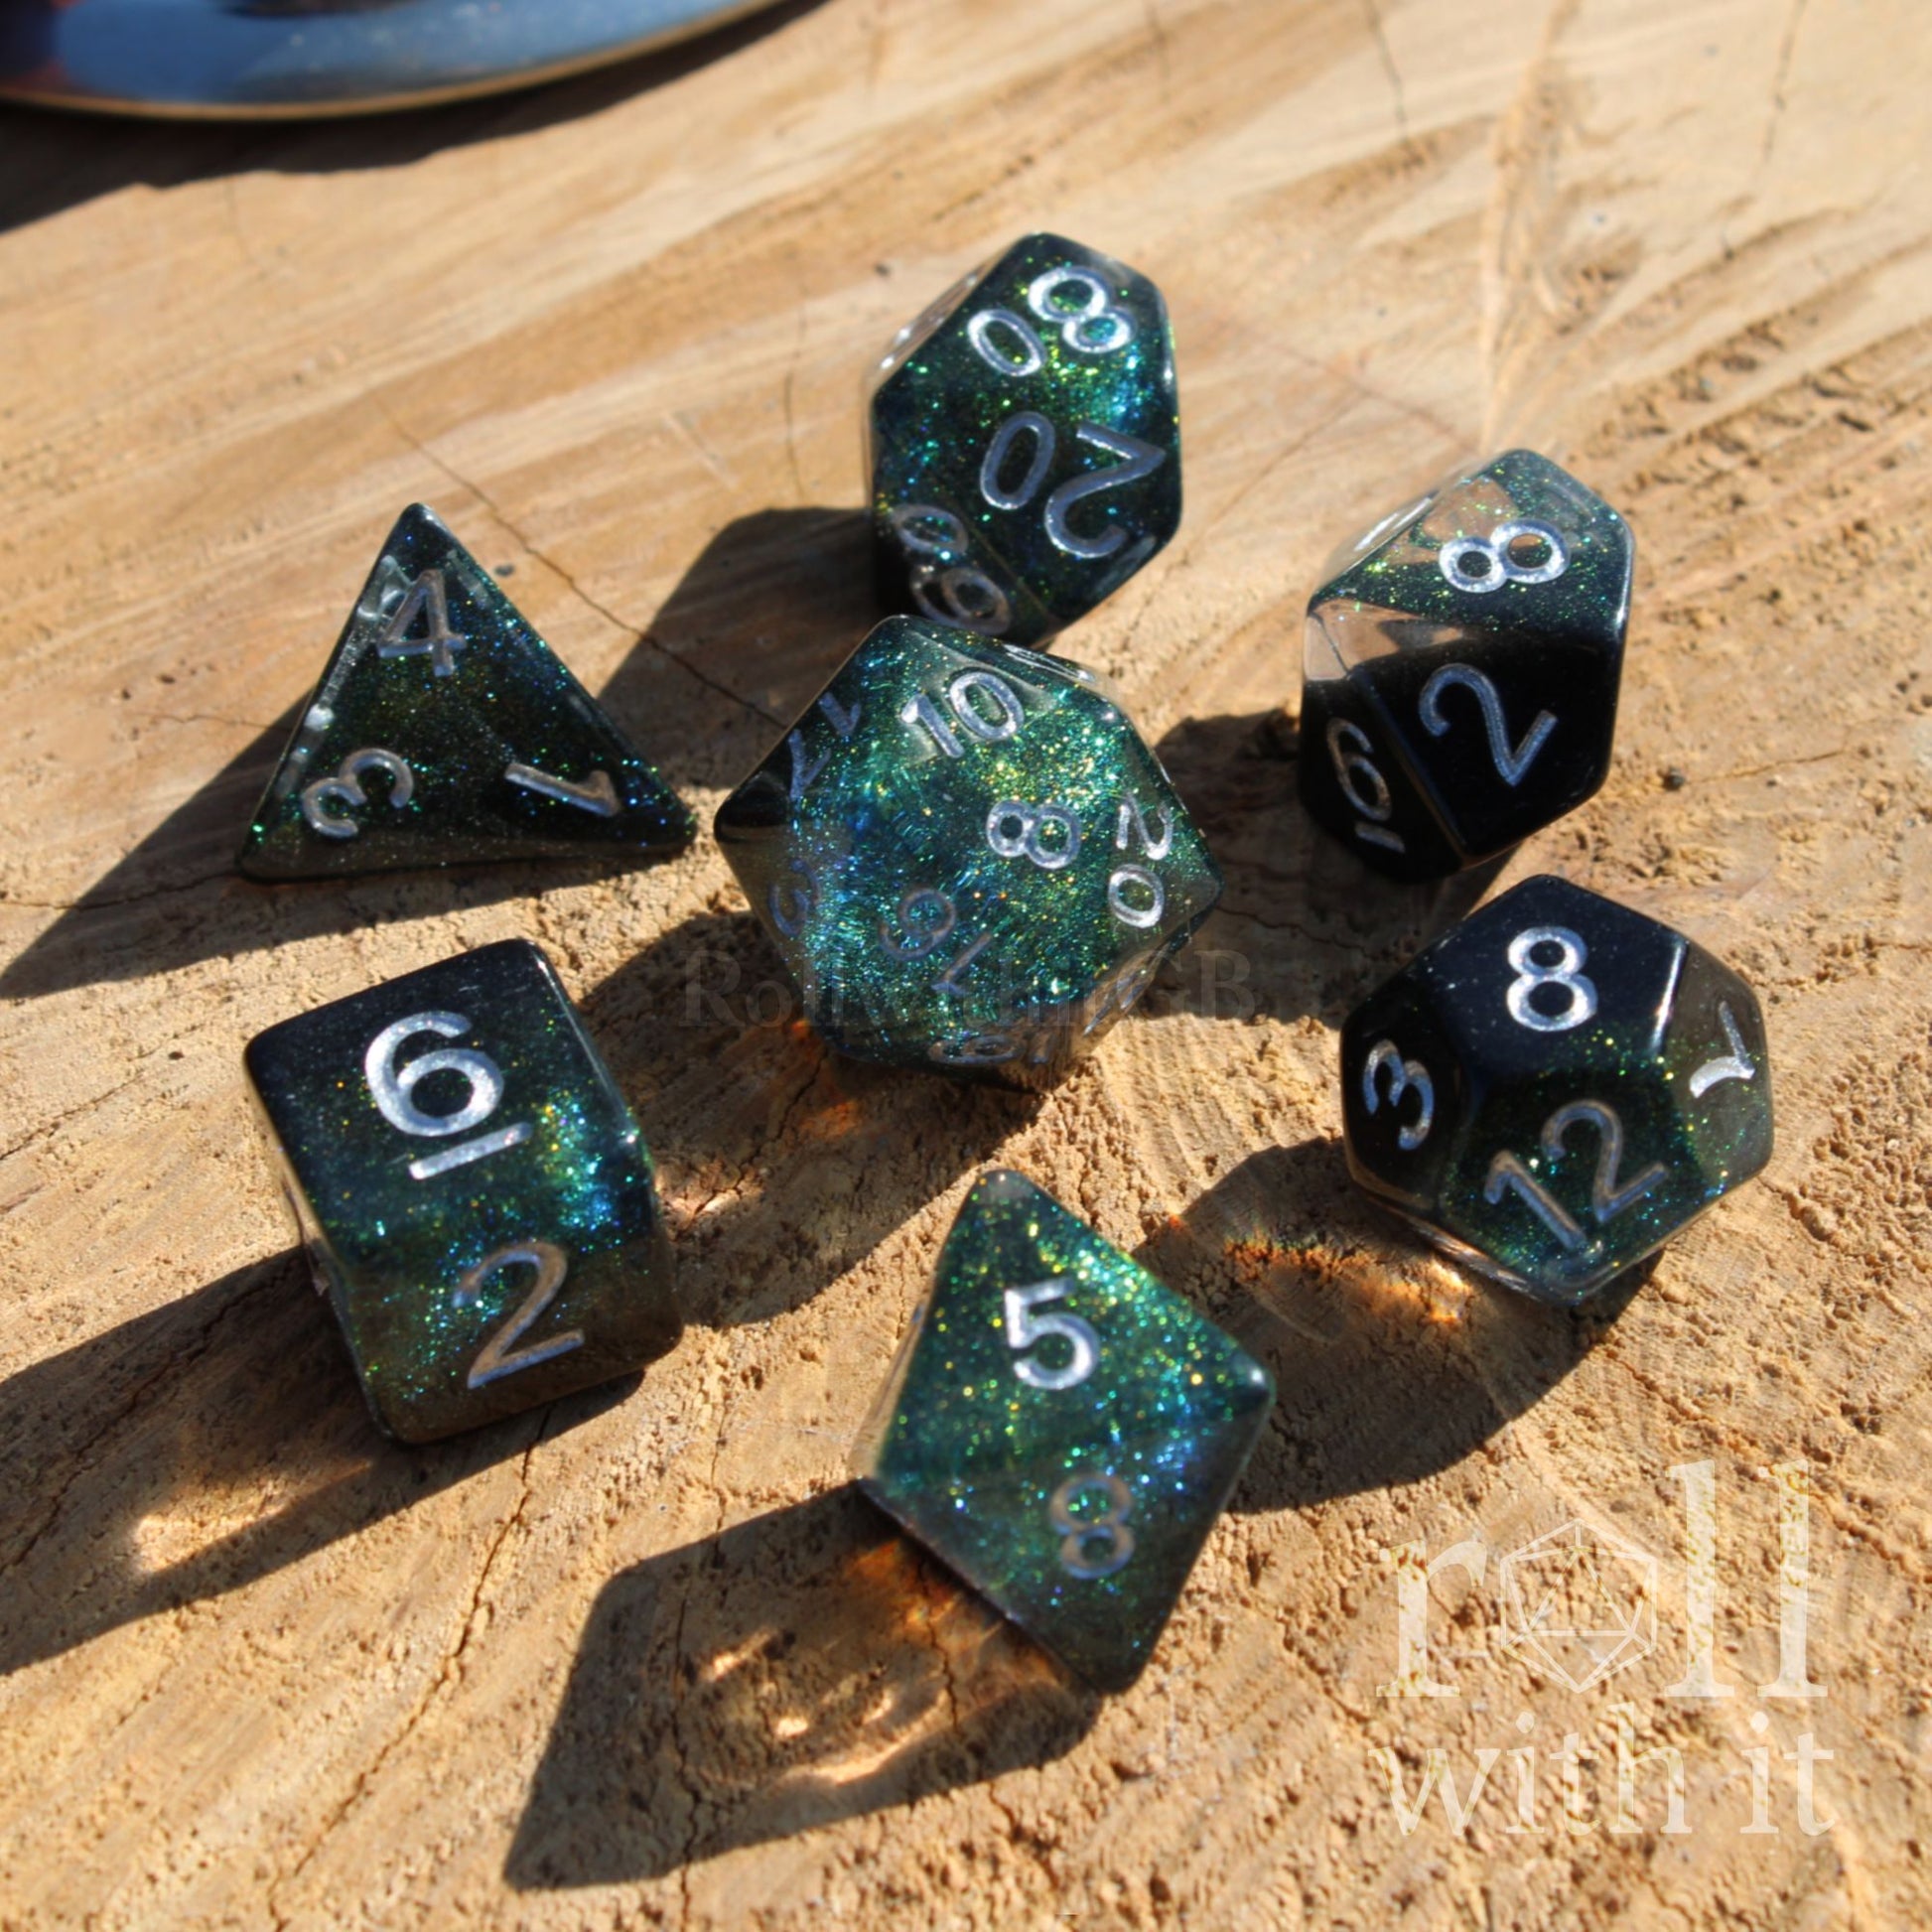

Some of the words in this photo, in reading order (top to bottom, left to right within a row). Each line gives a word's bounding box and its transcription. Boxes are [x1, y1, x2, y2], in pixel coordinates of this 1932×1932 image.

[967, 265, 1137, 379] 80
[978, 410, 1166, 559] 20
[1439, 518, 1571, 593] 8
[375, 568, 467, 677] 4
[901, 669, 1025, 759] 10
[1419, 662, 1558, 786] 2
[302, 748, 413, 839] 3
[504, 760, 621, 818] 1
[986, 799, 1080, 870] 8
[1107, 794, 1173, 929] 20
[1507, 925, 1597, 1033] 8
[364, 1011, 532, 1180] 6
[1363, 1038, 1434, 1151] 3
[1484, 1099, 1670, 1251] 12
[452, 1241, 586, 1390] 2
[1004, 1277, 1099, 1390] 5
[1049, 1472, 1135, 1579] 8
